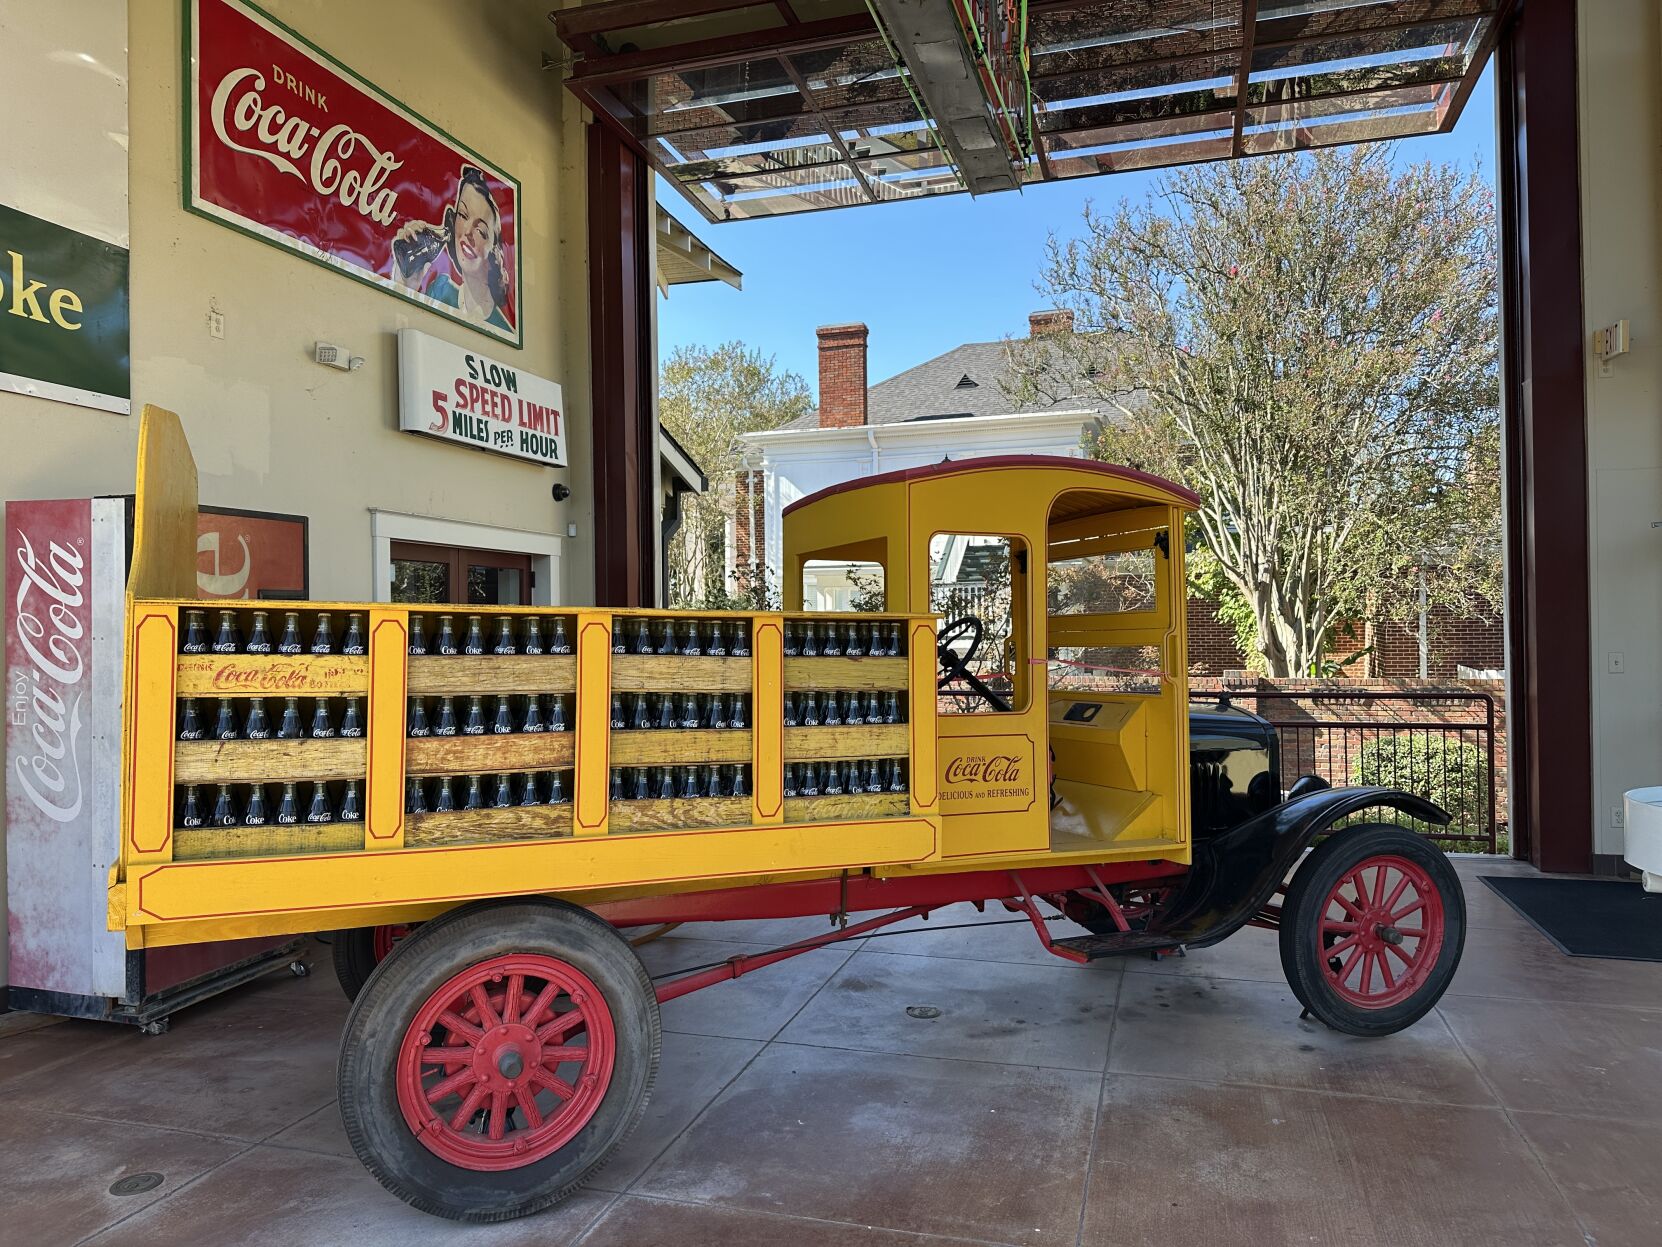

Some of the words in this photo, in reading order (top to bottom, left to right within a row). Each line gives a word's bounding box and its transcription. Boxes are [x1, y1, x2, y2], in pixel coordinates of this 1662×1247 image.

[272, 64, 329, 113] DRINK
[210, 67, 405, 226] Coca-Cola
[0, 250, 83, 331] ke
[464, 354, 518, 394] SLOW
[428, 389, 449, 436] 5
[452, 410, 489, 443] MILES
[493, 429, 514, 447] PER
[519, 429, 559, 460] HOUR
[454, 377, 513, 424] SPEED
[517, 398, 561, 437] LIMIT
[409, 646, 426, 654] Coke
[465, 646, 483, 654] Coke
[15, 528, 86, 823] Coca-Cola
[12, 669, 30, 727] Enjoy
[945, 755, 1023, 784] Coca-Cola
[987, 788, 1029, 798] REFRESHING
[246, 815, 265, 825] Coke
[278, 814, 297, 823] Coke
[342, 810, 360, 819] Coke
